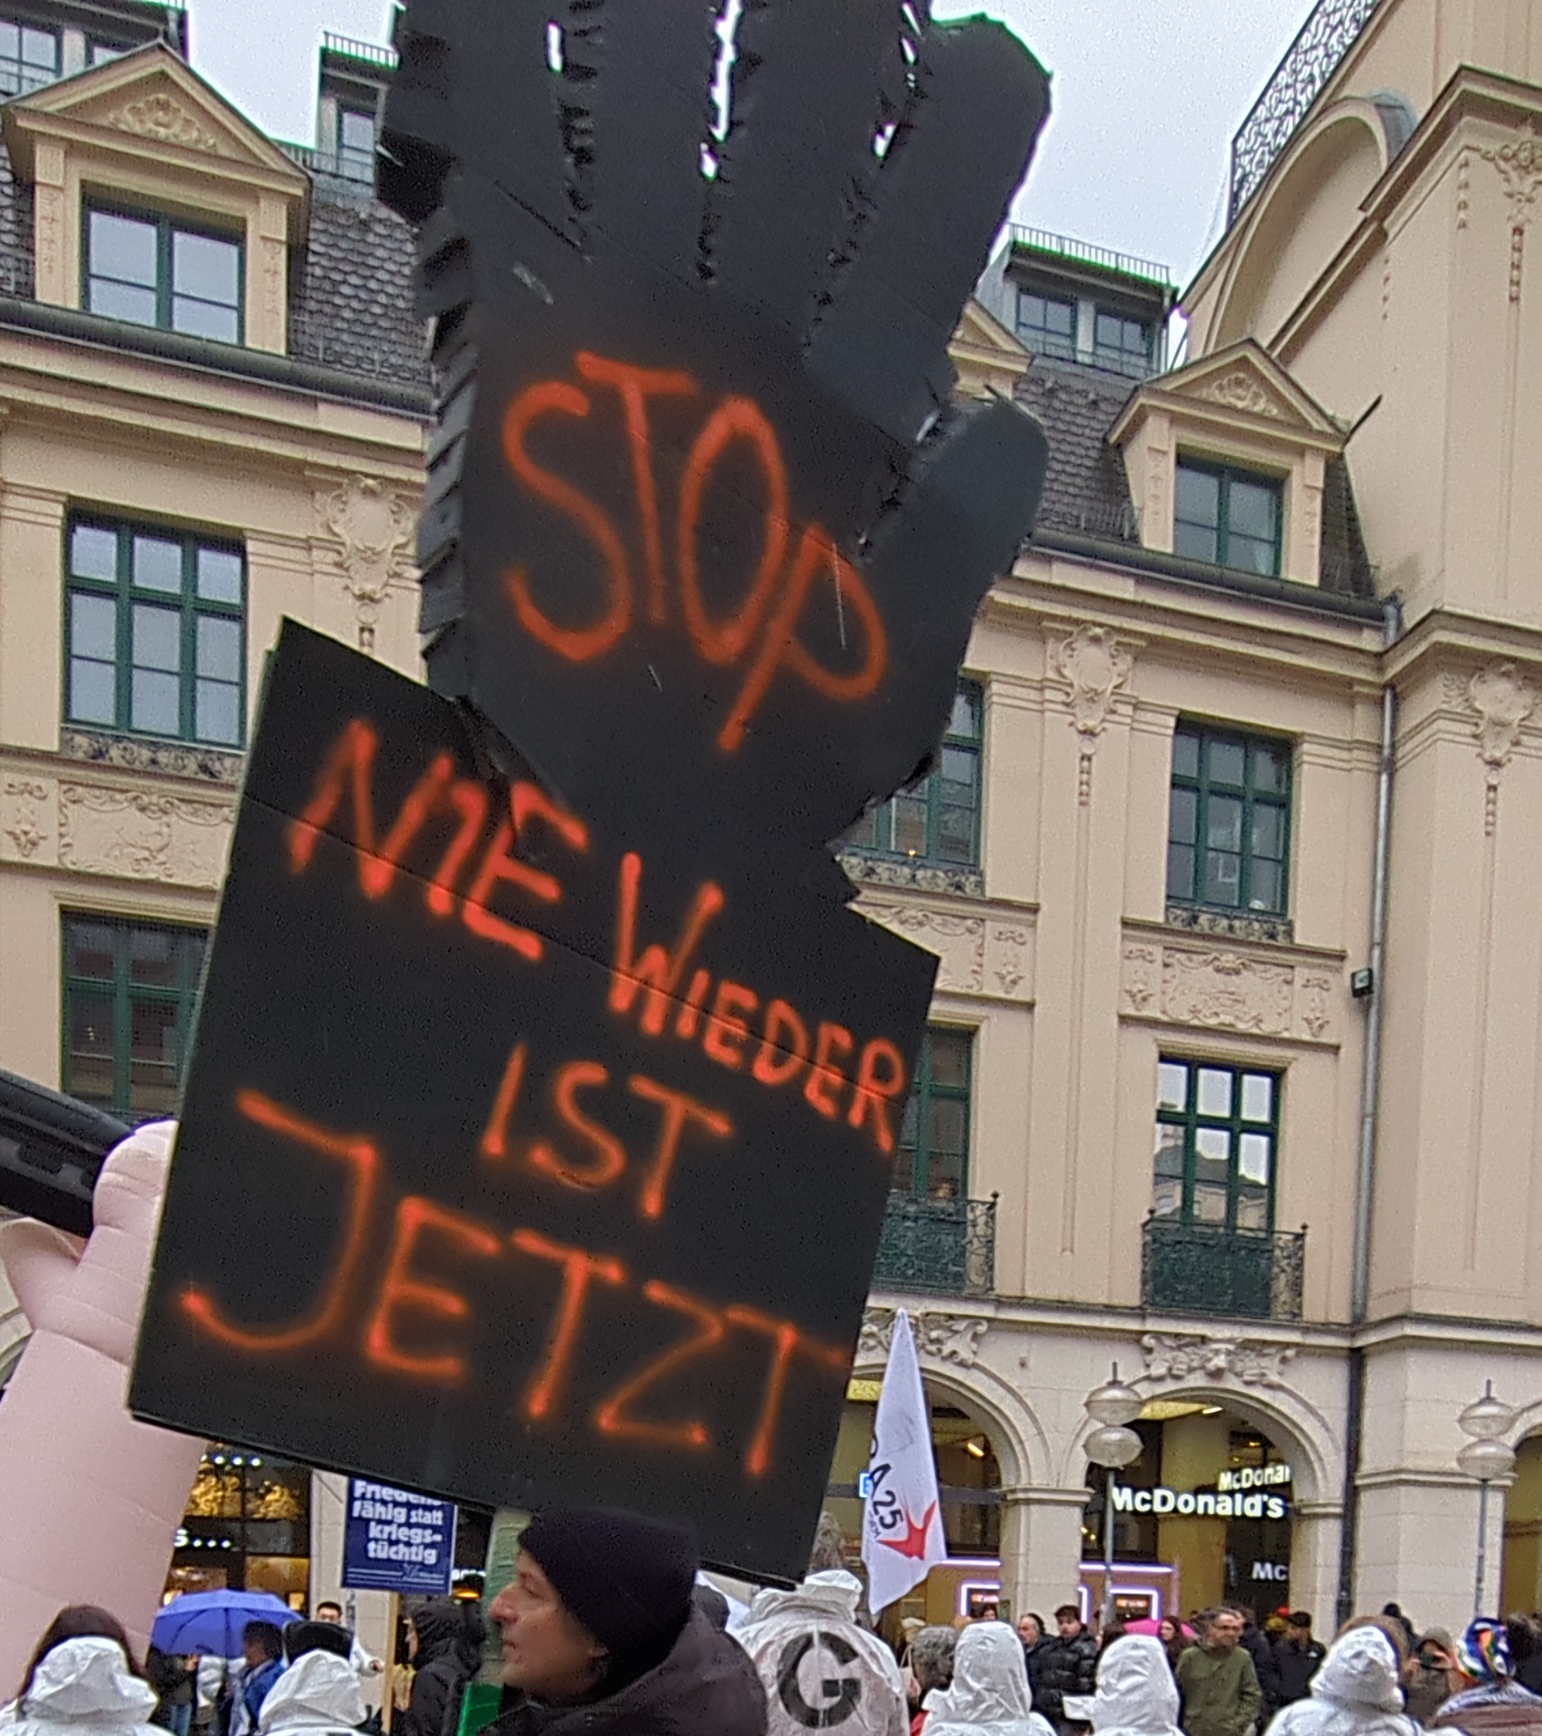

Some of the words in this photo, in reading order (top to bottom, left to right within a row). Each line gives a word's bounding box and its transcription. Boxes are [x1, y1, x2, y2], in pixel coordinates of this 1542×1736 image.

[502, 348, 889, 752] STOP
[286, 719, 589, 961] NIE
[608, 853, 906, 1152] WIEDER
[480, 1044, 734, 1217] IST
[177, 1088, 849, 1473] JETZT
[351, 1500, 408, 1524] fähig
[409, 1508, 444, 1526] statt
[368, 1521, 444, 1545] kriegs-
[1111, 1486, 1285, 1519] McDonald's
[367, 1540, 439, 1565] tüchtig
[778, 1632, 861, 1728] G
